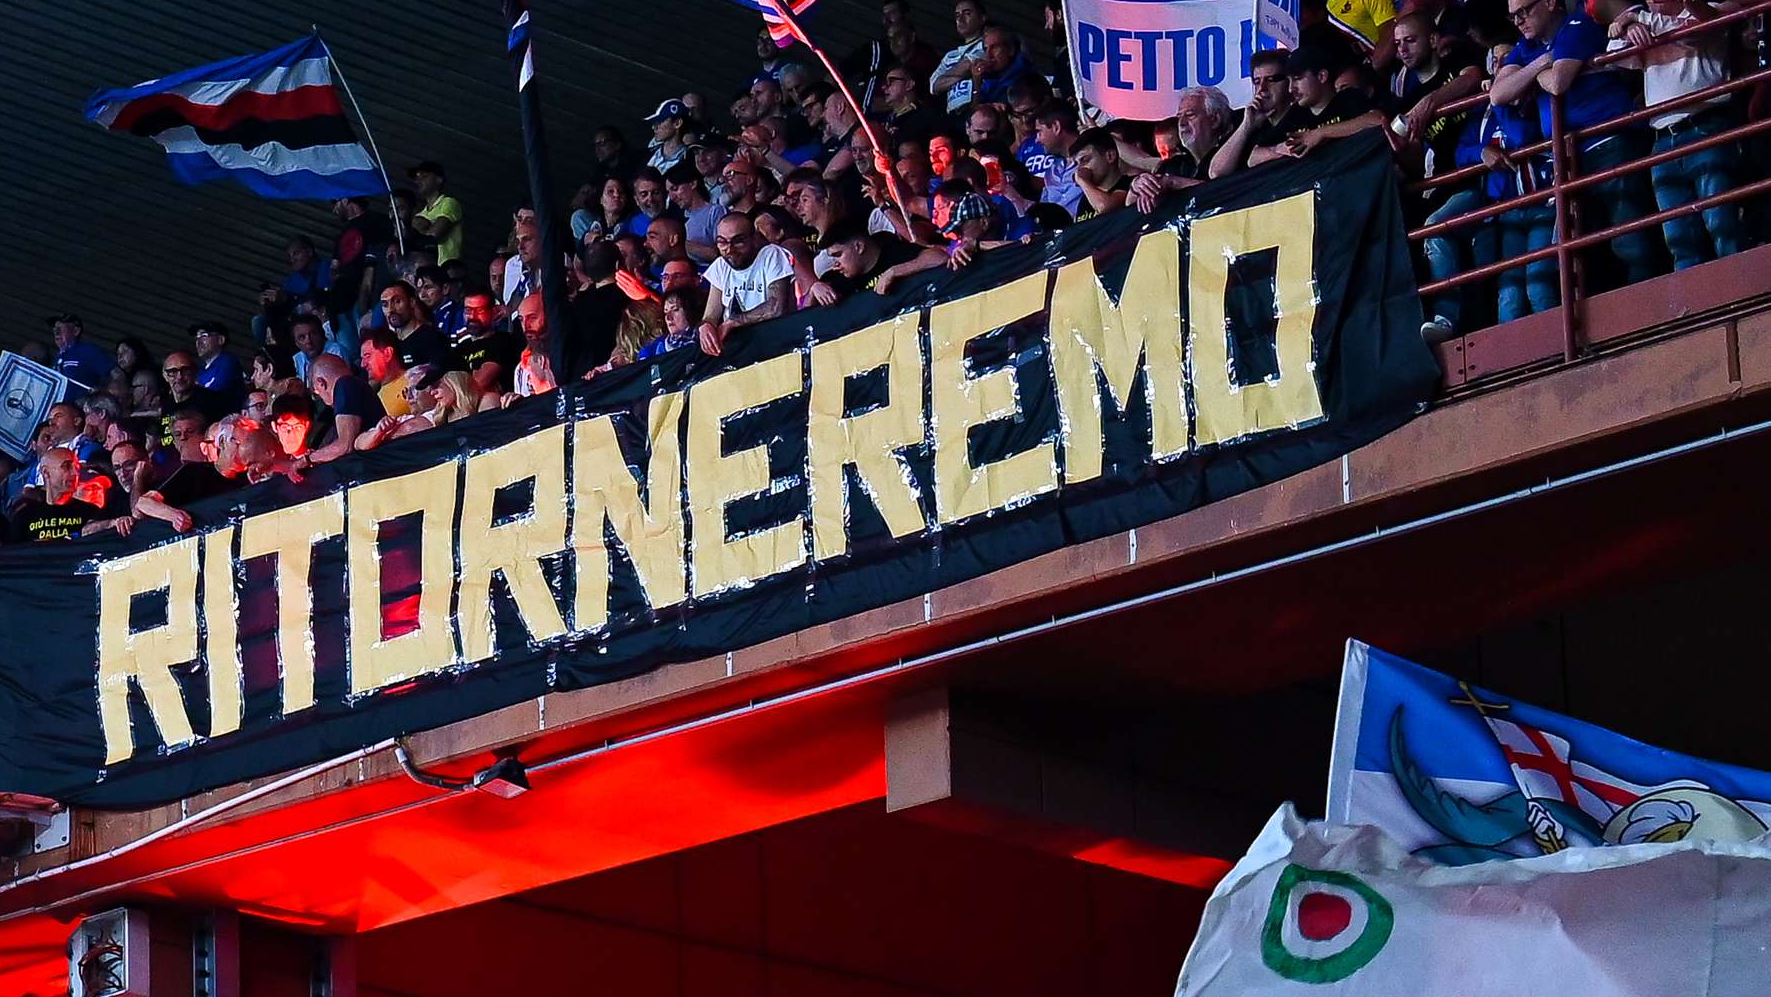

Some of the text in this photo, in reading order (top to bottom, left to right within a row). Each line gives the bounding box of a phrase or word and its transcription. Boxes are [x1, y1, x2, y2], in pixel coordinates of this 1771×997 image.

[1077, 20, 1225, 91] PETTO
[96, 190, 1322, 766] RITORNEREMO
[44, 517, 57, 527] LE
[58, 516, 82, 526] MANI
